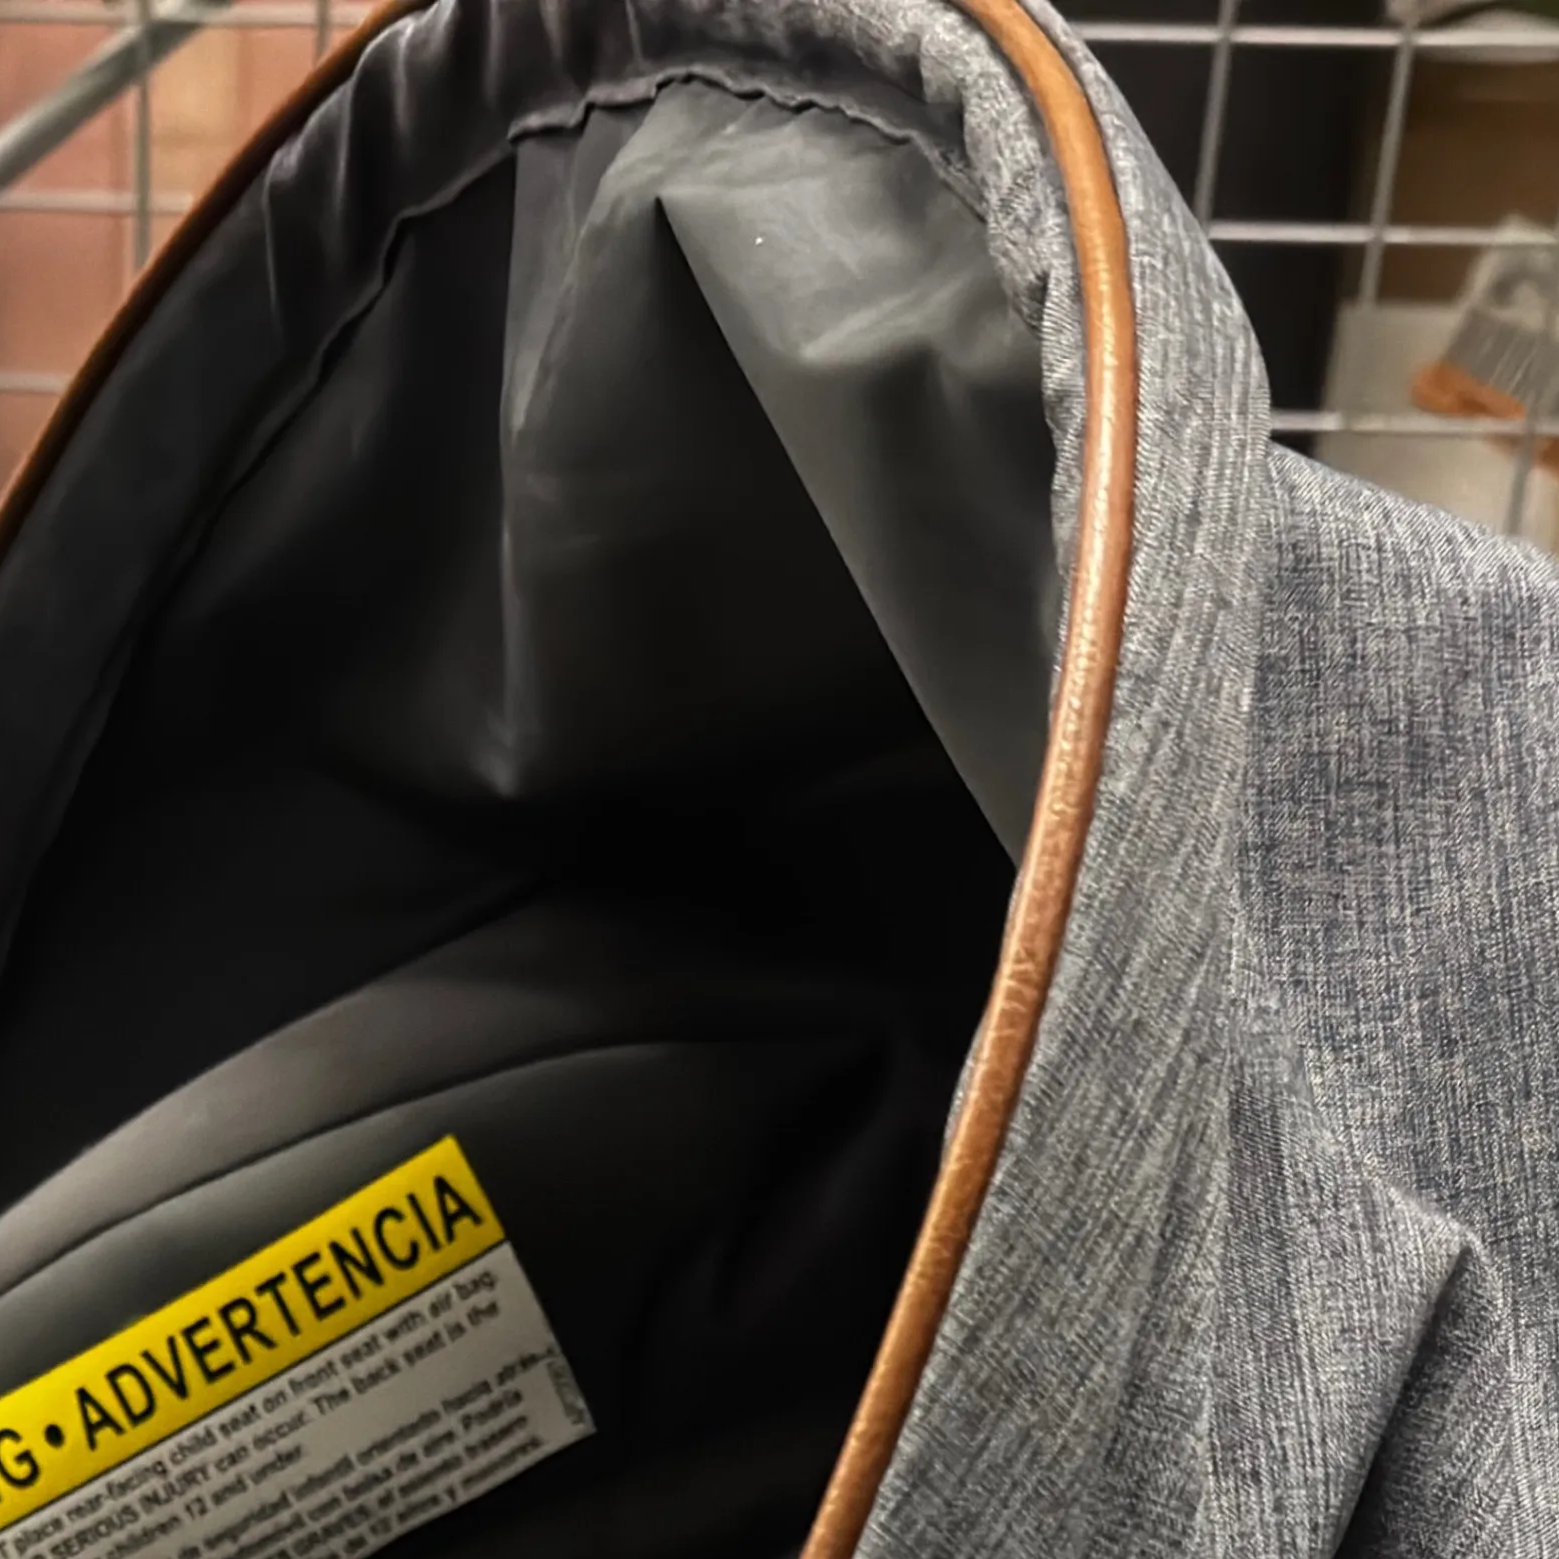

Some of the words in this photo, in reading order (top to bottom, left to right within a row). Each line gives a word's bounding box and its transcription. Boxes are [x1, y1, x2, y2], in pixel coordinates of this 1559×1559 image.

[14, 1517, 63, 1555] place
[67, 1460, 168, 1519] rear-facing
[170, 1427, 216, 1464] child
[219, 1404, 259, 1436] seat
[262, 1390, 287, 1412] on
[288, 1360, 337, 1393] front
[341, 1335, 380, 1368] seat
[385, 1311, 423, 1341] with
[429, 1293, 451, 1317] air
[73, 1175, 482, 1452] ADVERTENCIA
[140, 1465, 208, 1512] INJURY
[215, 1445, 247, 1471] can
[312, 1387, 350, 1413] The
[351, 1359, 400, 1393] back
[403, 1331, 444, 1365] seat
[446, 1322, 466, 1341] is
[467, 1301, 498, 1325] the
[184, 1496, 207, 1516] 12
[211, 1475, 246, 1505] and
